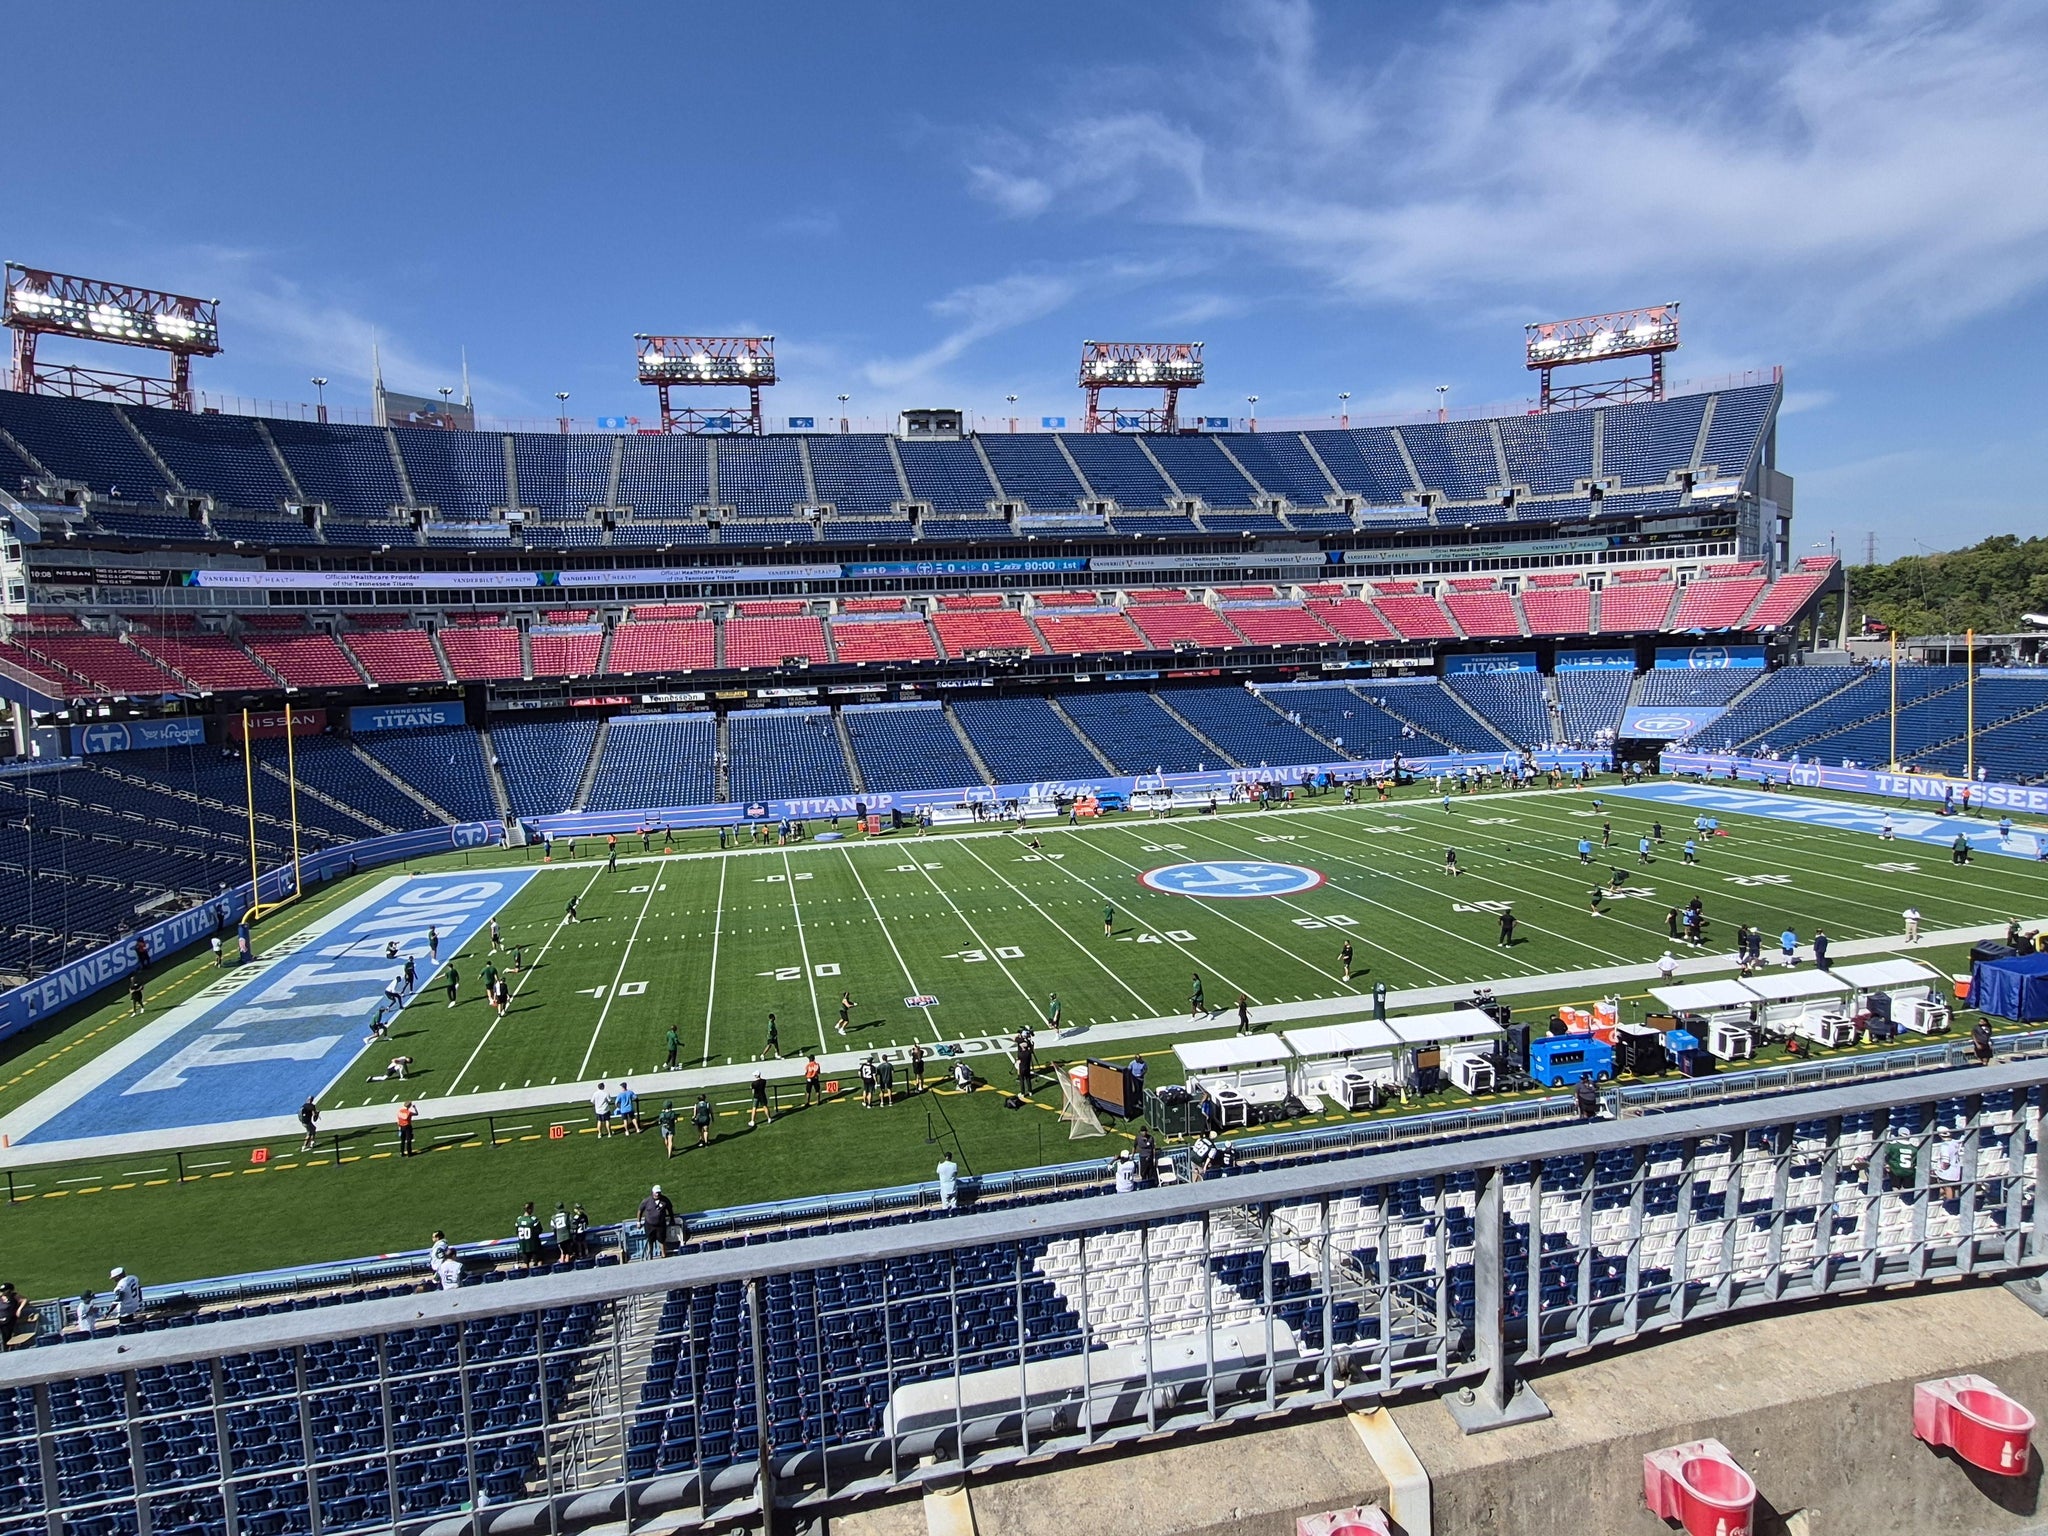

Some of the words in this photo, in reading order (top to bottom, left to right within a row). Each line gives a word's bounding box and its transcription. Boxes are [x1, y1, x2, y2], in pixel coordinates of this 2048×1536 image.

[948, 564, 955, 573] 0
[982, 562, 989, 572] 0
[1024, 562, 1055, 571] 90:00
[1462, 660, 1520, 672] TITANS
[1560, 656, 1630, 666] NISSAN
[649, 694, 698, 702] Tennessean
[242, 714, 316, 728] NISSAN
[372, 712, 446, 728] TITANS
[160, 724, 200, 744] Kroger
[1227, 768, 1288, 784] TITAN
[1874, 774, 2048, 811] TENNESSEE
[785, 798, 858, 816] TITAN
[1291, 914, 1360, 930] 50
[1136, 929, 1198, 944] 40
[958, 946, 1026, 962] 30
[774, 963, 842, 981] 20
[120, 881, 504, 1096] TITANS
[594, 981, 650, 998] 10
[828, 1082, 836, 1092] 20
[551, 1127, 562, 1138] 10
[256, 1150, 268, 1161] G
[518, 1227, 530, 1240] 20
